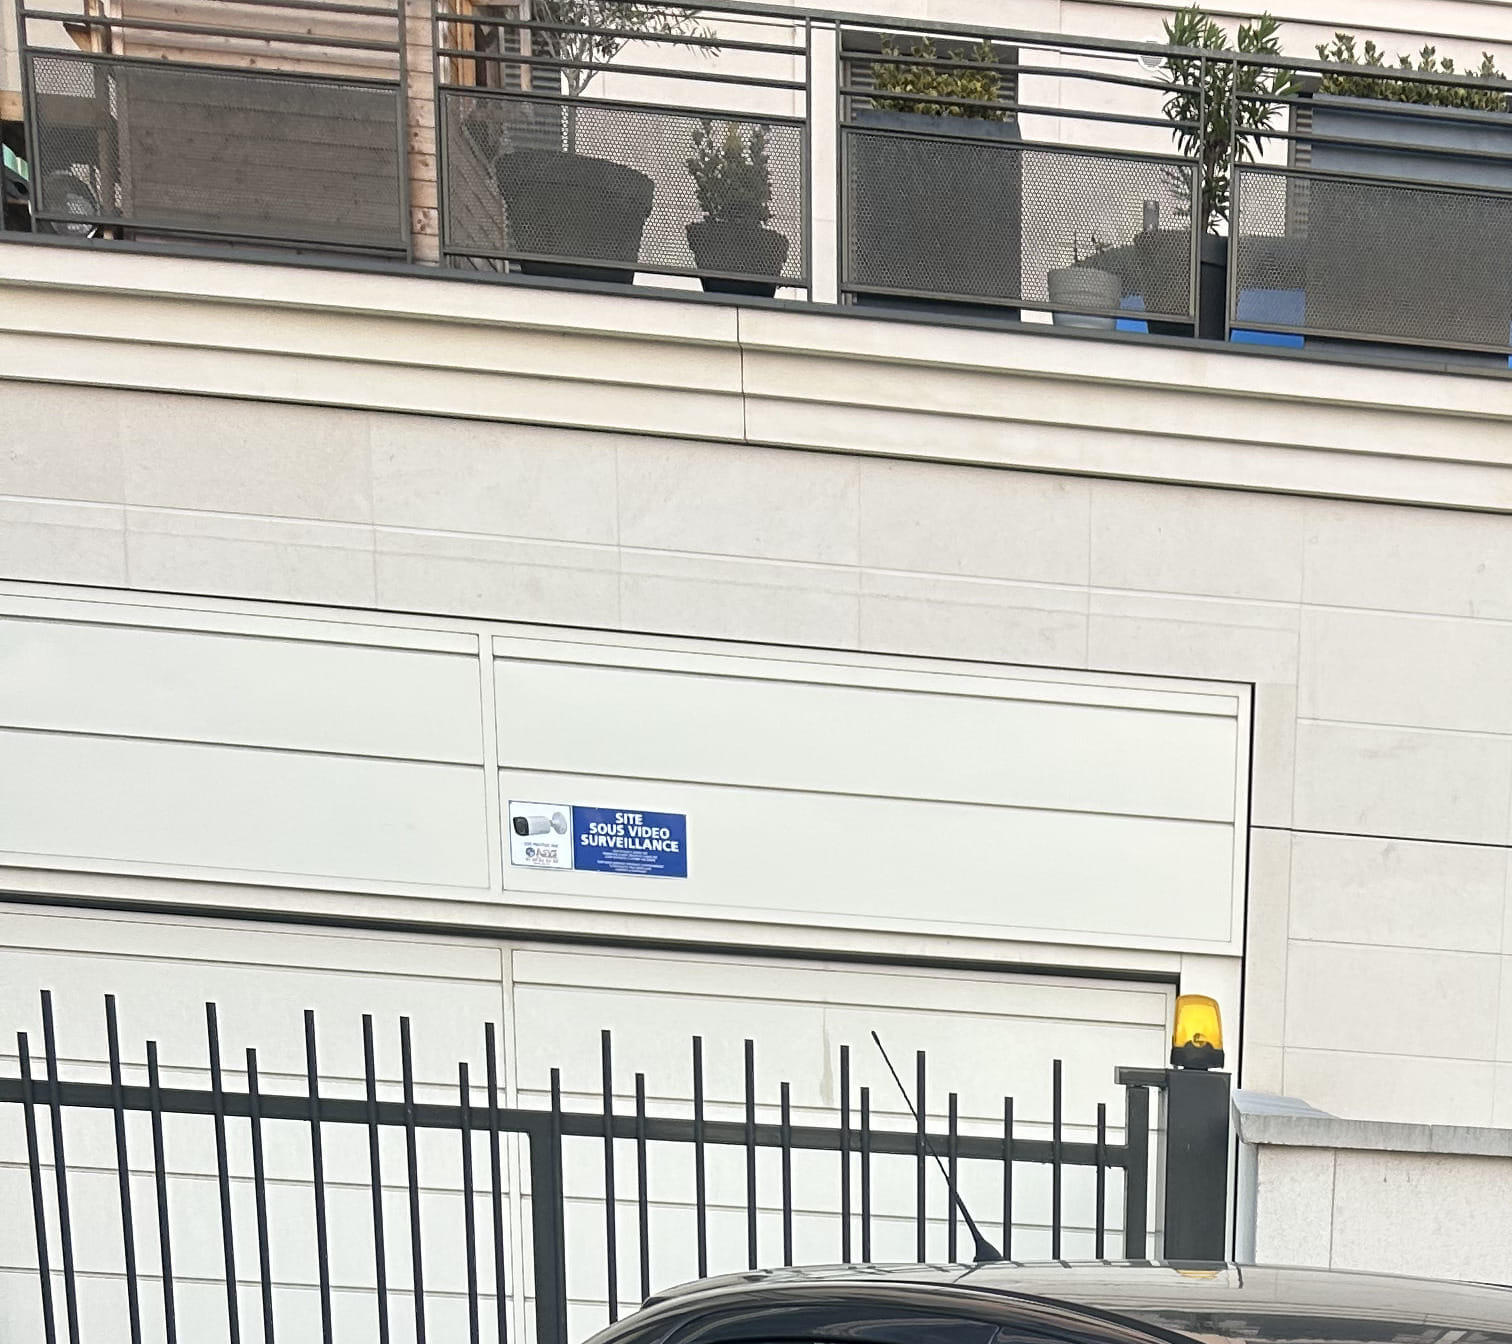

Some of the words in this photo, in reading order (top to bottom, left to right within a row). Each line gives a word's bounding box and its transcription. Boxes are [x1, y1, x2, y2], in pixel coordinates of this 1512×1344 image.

[615, 812, 643, 825] SITE
[589, 822, 625, 836] SOUS
[628, 825, 670, 839] VIDEO
[580, 834, 680, 852] SURVEILLANCE
